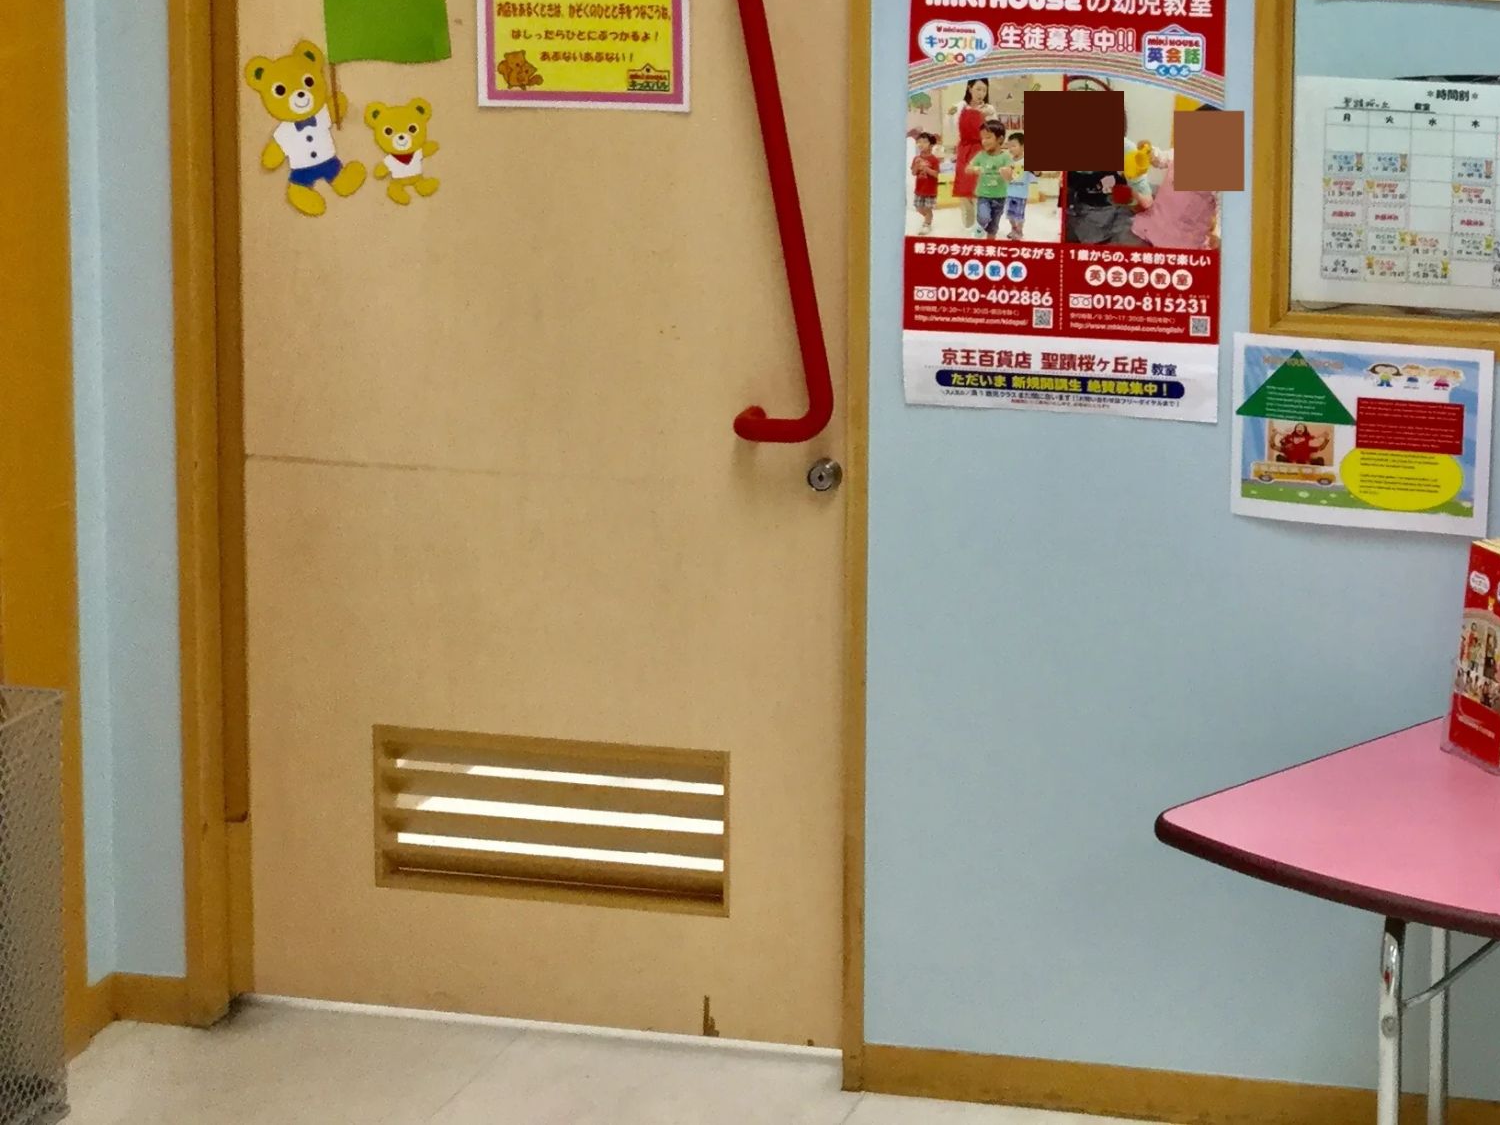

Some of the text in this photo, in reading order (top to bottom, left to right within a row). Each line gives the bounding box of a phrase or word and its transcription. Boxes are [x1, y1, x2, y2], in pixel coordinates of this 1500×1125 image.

[1148, 47, 1200, 65] 英会話
[938, 286, 1054, 306] 0120-402886
[1093, 293, 1208, 314] 0120-815231
[941, 347, 1177, 376] 京王百貨店 聖蹟桜ヶ丘店 教室
[951, 373, 1006, 388] ただいま
